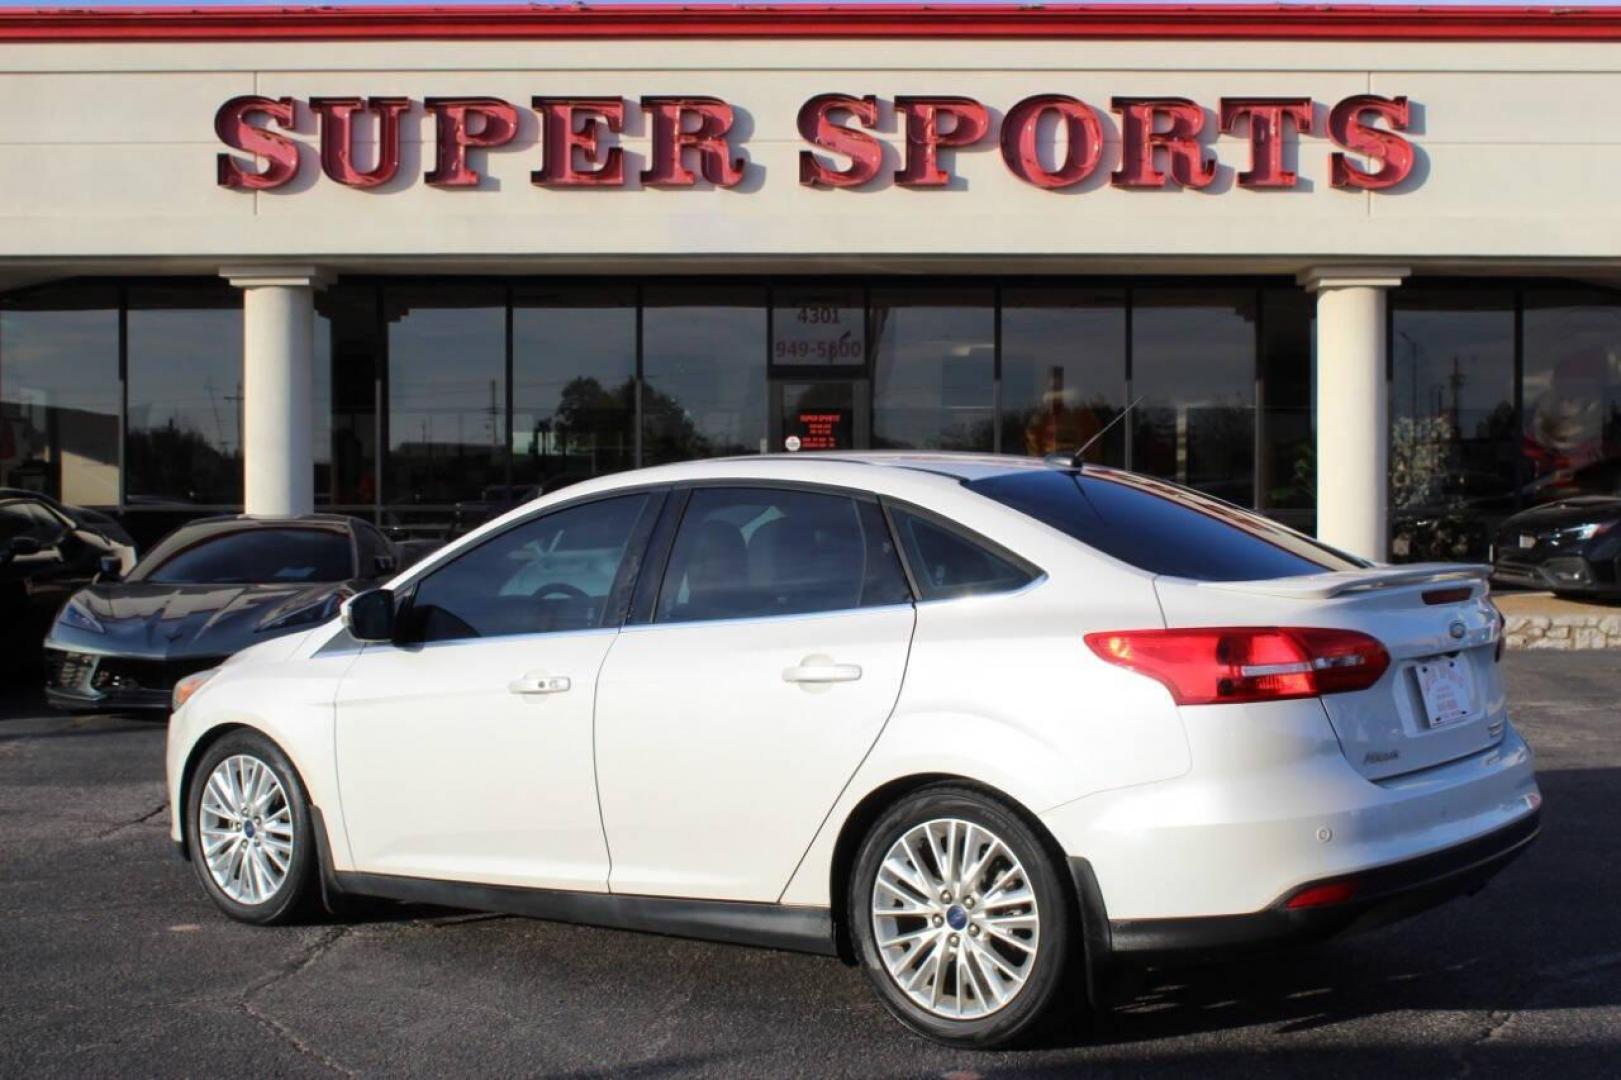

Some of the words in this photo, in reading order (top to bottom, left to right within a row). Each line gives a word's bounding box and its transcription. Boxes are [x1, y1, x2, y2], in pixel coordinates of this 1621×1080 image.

[214, 94, 746, 191] SUPER
[796, 93, 1415, 191] SPORTS
[798, 305, 841, 324] 4301
